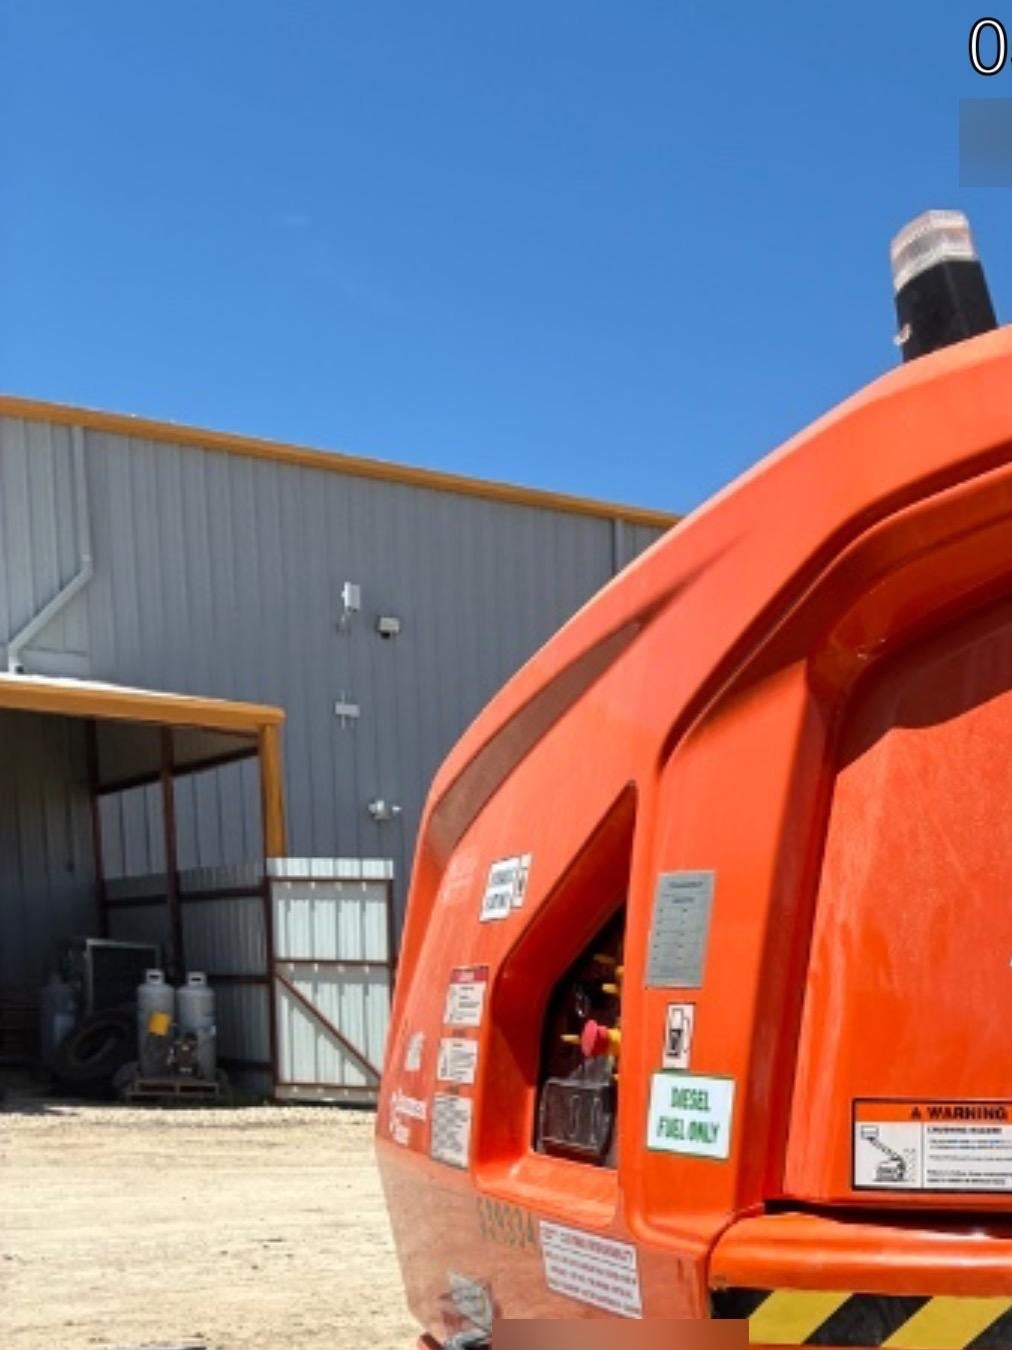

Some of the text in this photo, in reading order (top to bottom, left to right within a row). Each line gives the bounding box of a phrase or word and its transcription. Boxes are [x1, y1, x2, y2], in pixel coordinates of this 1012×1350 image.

[671, 1087, 711, 1112] DIESEL
[926, 1106, 1008, 1120] WARNING
[656, 1116, 685, 1140] FUEL
